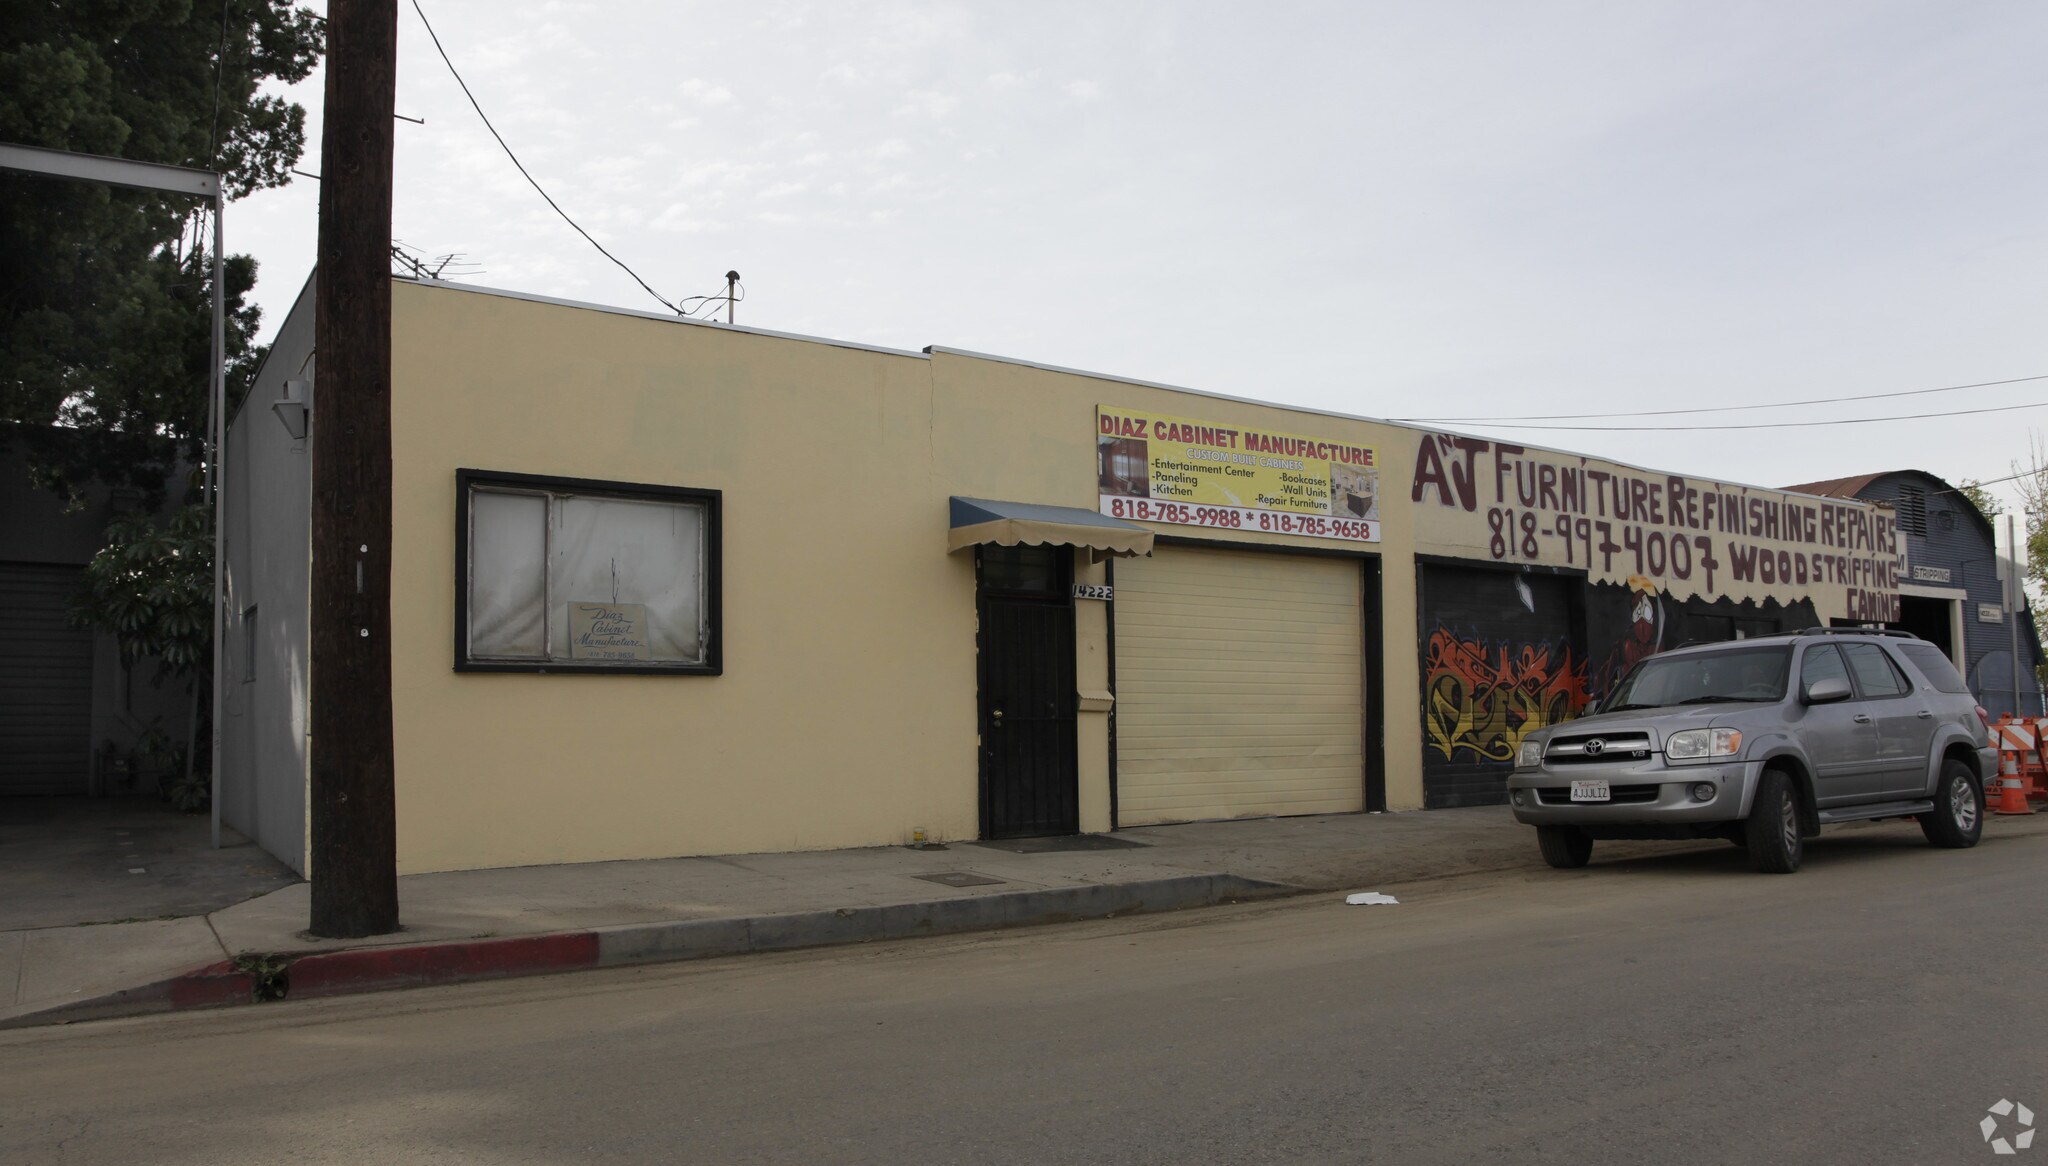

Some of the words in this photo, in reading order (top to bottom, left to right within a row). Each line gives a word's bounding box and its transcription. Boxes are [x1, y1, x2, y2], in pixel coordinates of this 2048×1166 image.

[1100, 414, 1148, 439] DIAZ
[1154, 421, 1239, 449] CABINET
[1245, 432, 1374, 467] MANUFACTURE
[1186, 448, 1229, 462] CUSTOM
[1232, 453, 1257, 466] BUILT
[1260, 457, 1304, 471] CABINETS
[1151, 459, 1222, 475] -Entertainment
[1225, 466, 1255, 478] Center
[1152, 471, 1198, 487] -Paneling
[1279, 473, 1327, 487] -Bookcases
[1152, 484, 1193, 497] -Kitchen
[1280, 485, 1303, 496] -Wall
[1306, 488, 1328, 498] Units
[1255, 494, 1288, 507] -Repair
[1290, 497, 1328, 510] Furniture
[1111, 499, 1241, 528] 818-785-9988
[1259, 513, 1370, 539] 818-785-9658
[1728, 541, 1808, 584] WOOD
[1914, 567, 1949, 581] STRIPPING
[1073, 585, 1112, 599] 14222
[580, 606, 634, 624] Diaz
[591, 620, 634, 636] Cabinet
[575, 633, 645, 648] Manufacture
